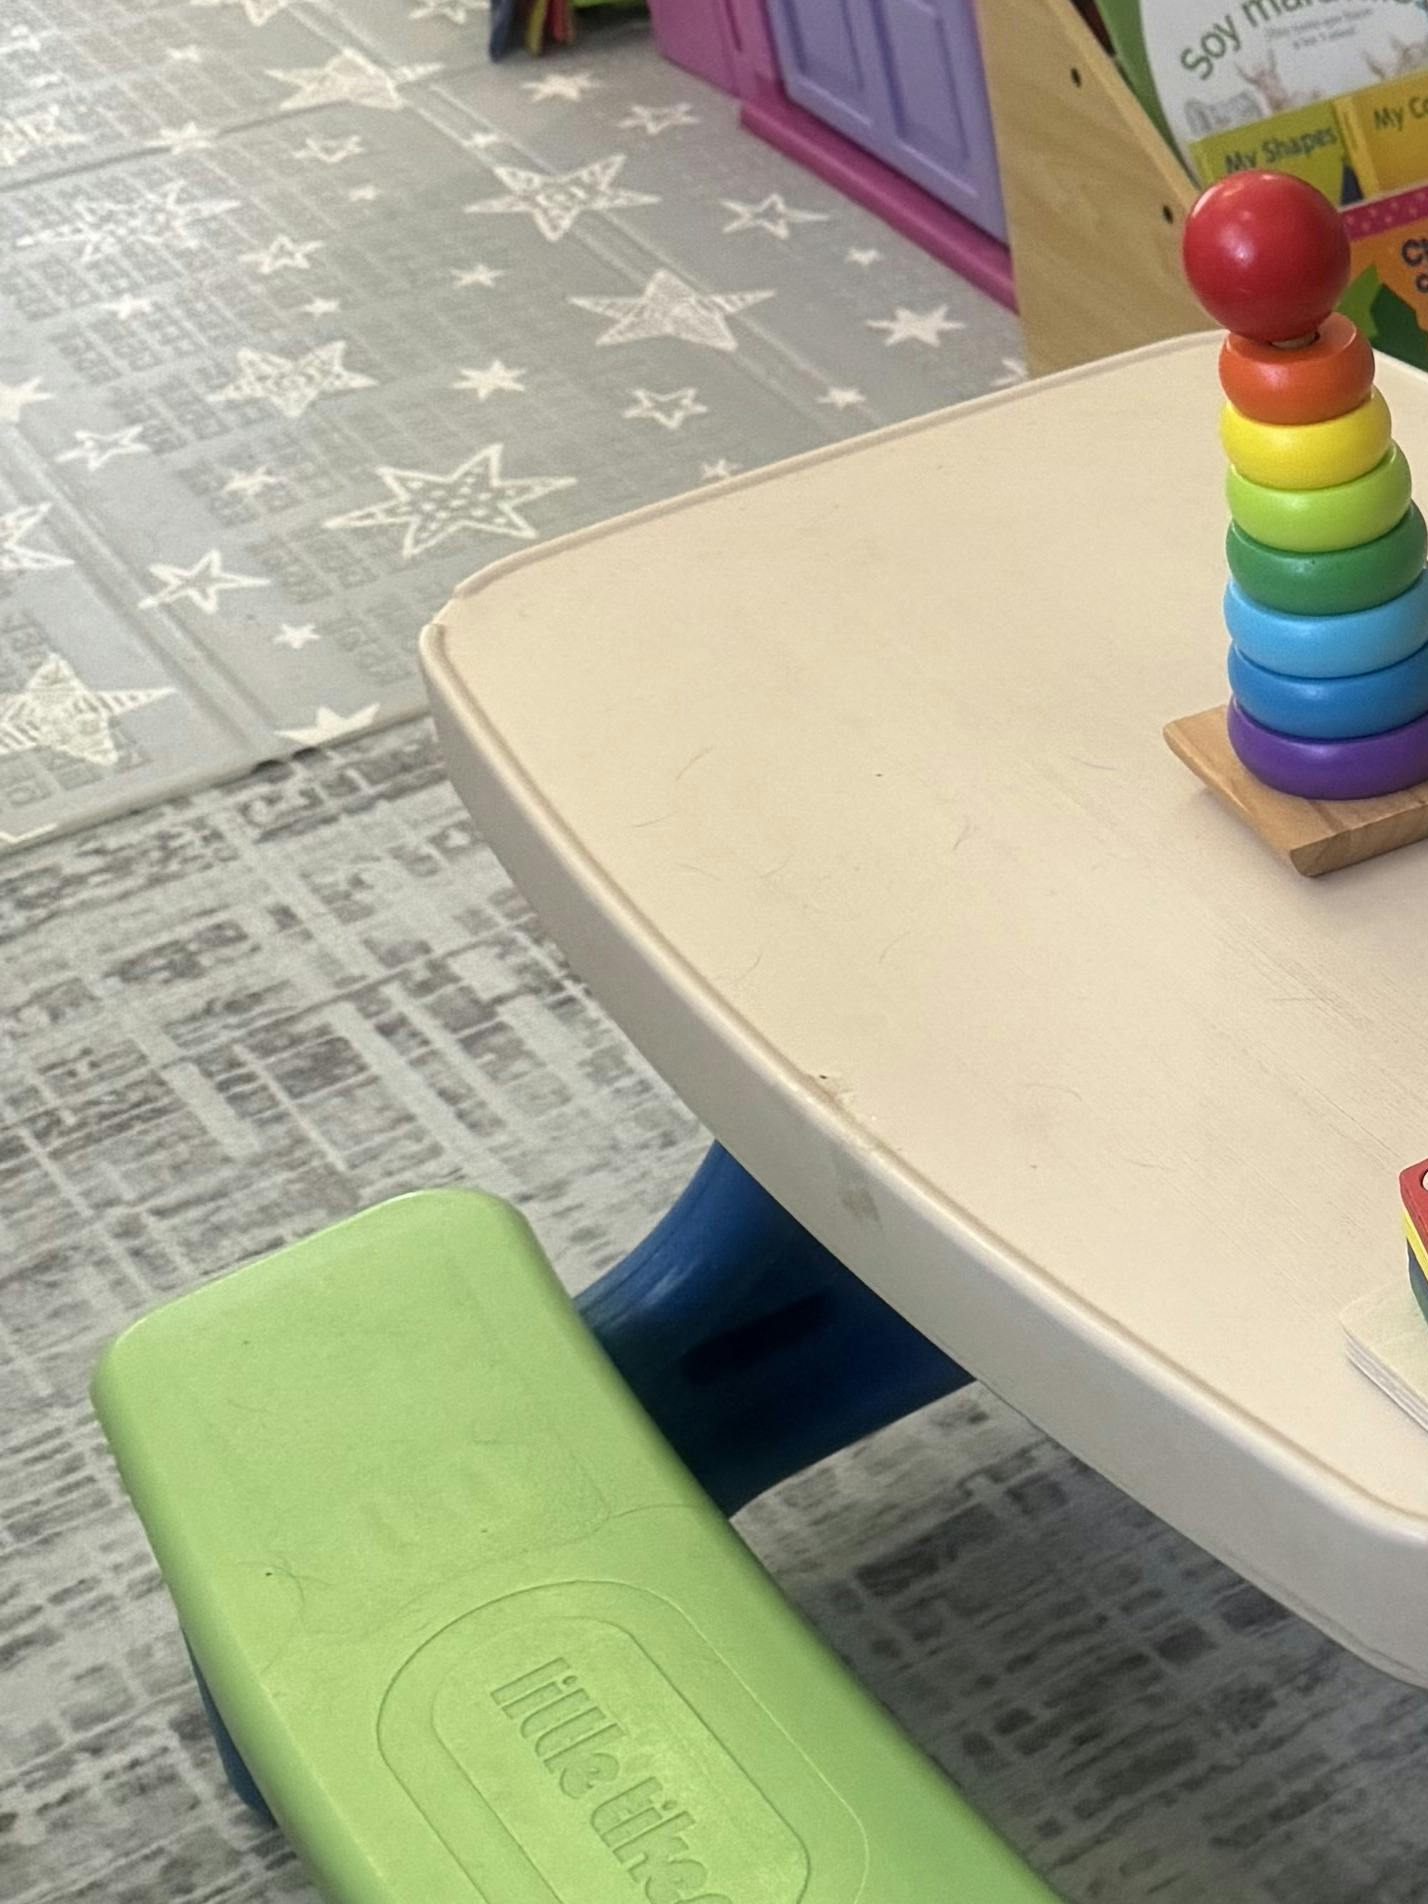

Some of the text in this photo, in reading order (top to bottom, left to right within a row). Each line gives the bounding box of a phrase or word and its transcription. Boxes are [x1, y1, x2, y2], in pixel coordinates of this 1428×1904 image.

[1180, 12, 1243, 83] Soy
[1374, 105, 1405, 132] My
[1224, 125, 1339, 173] My Shapes
[490, 1656, 630, 1800] little
